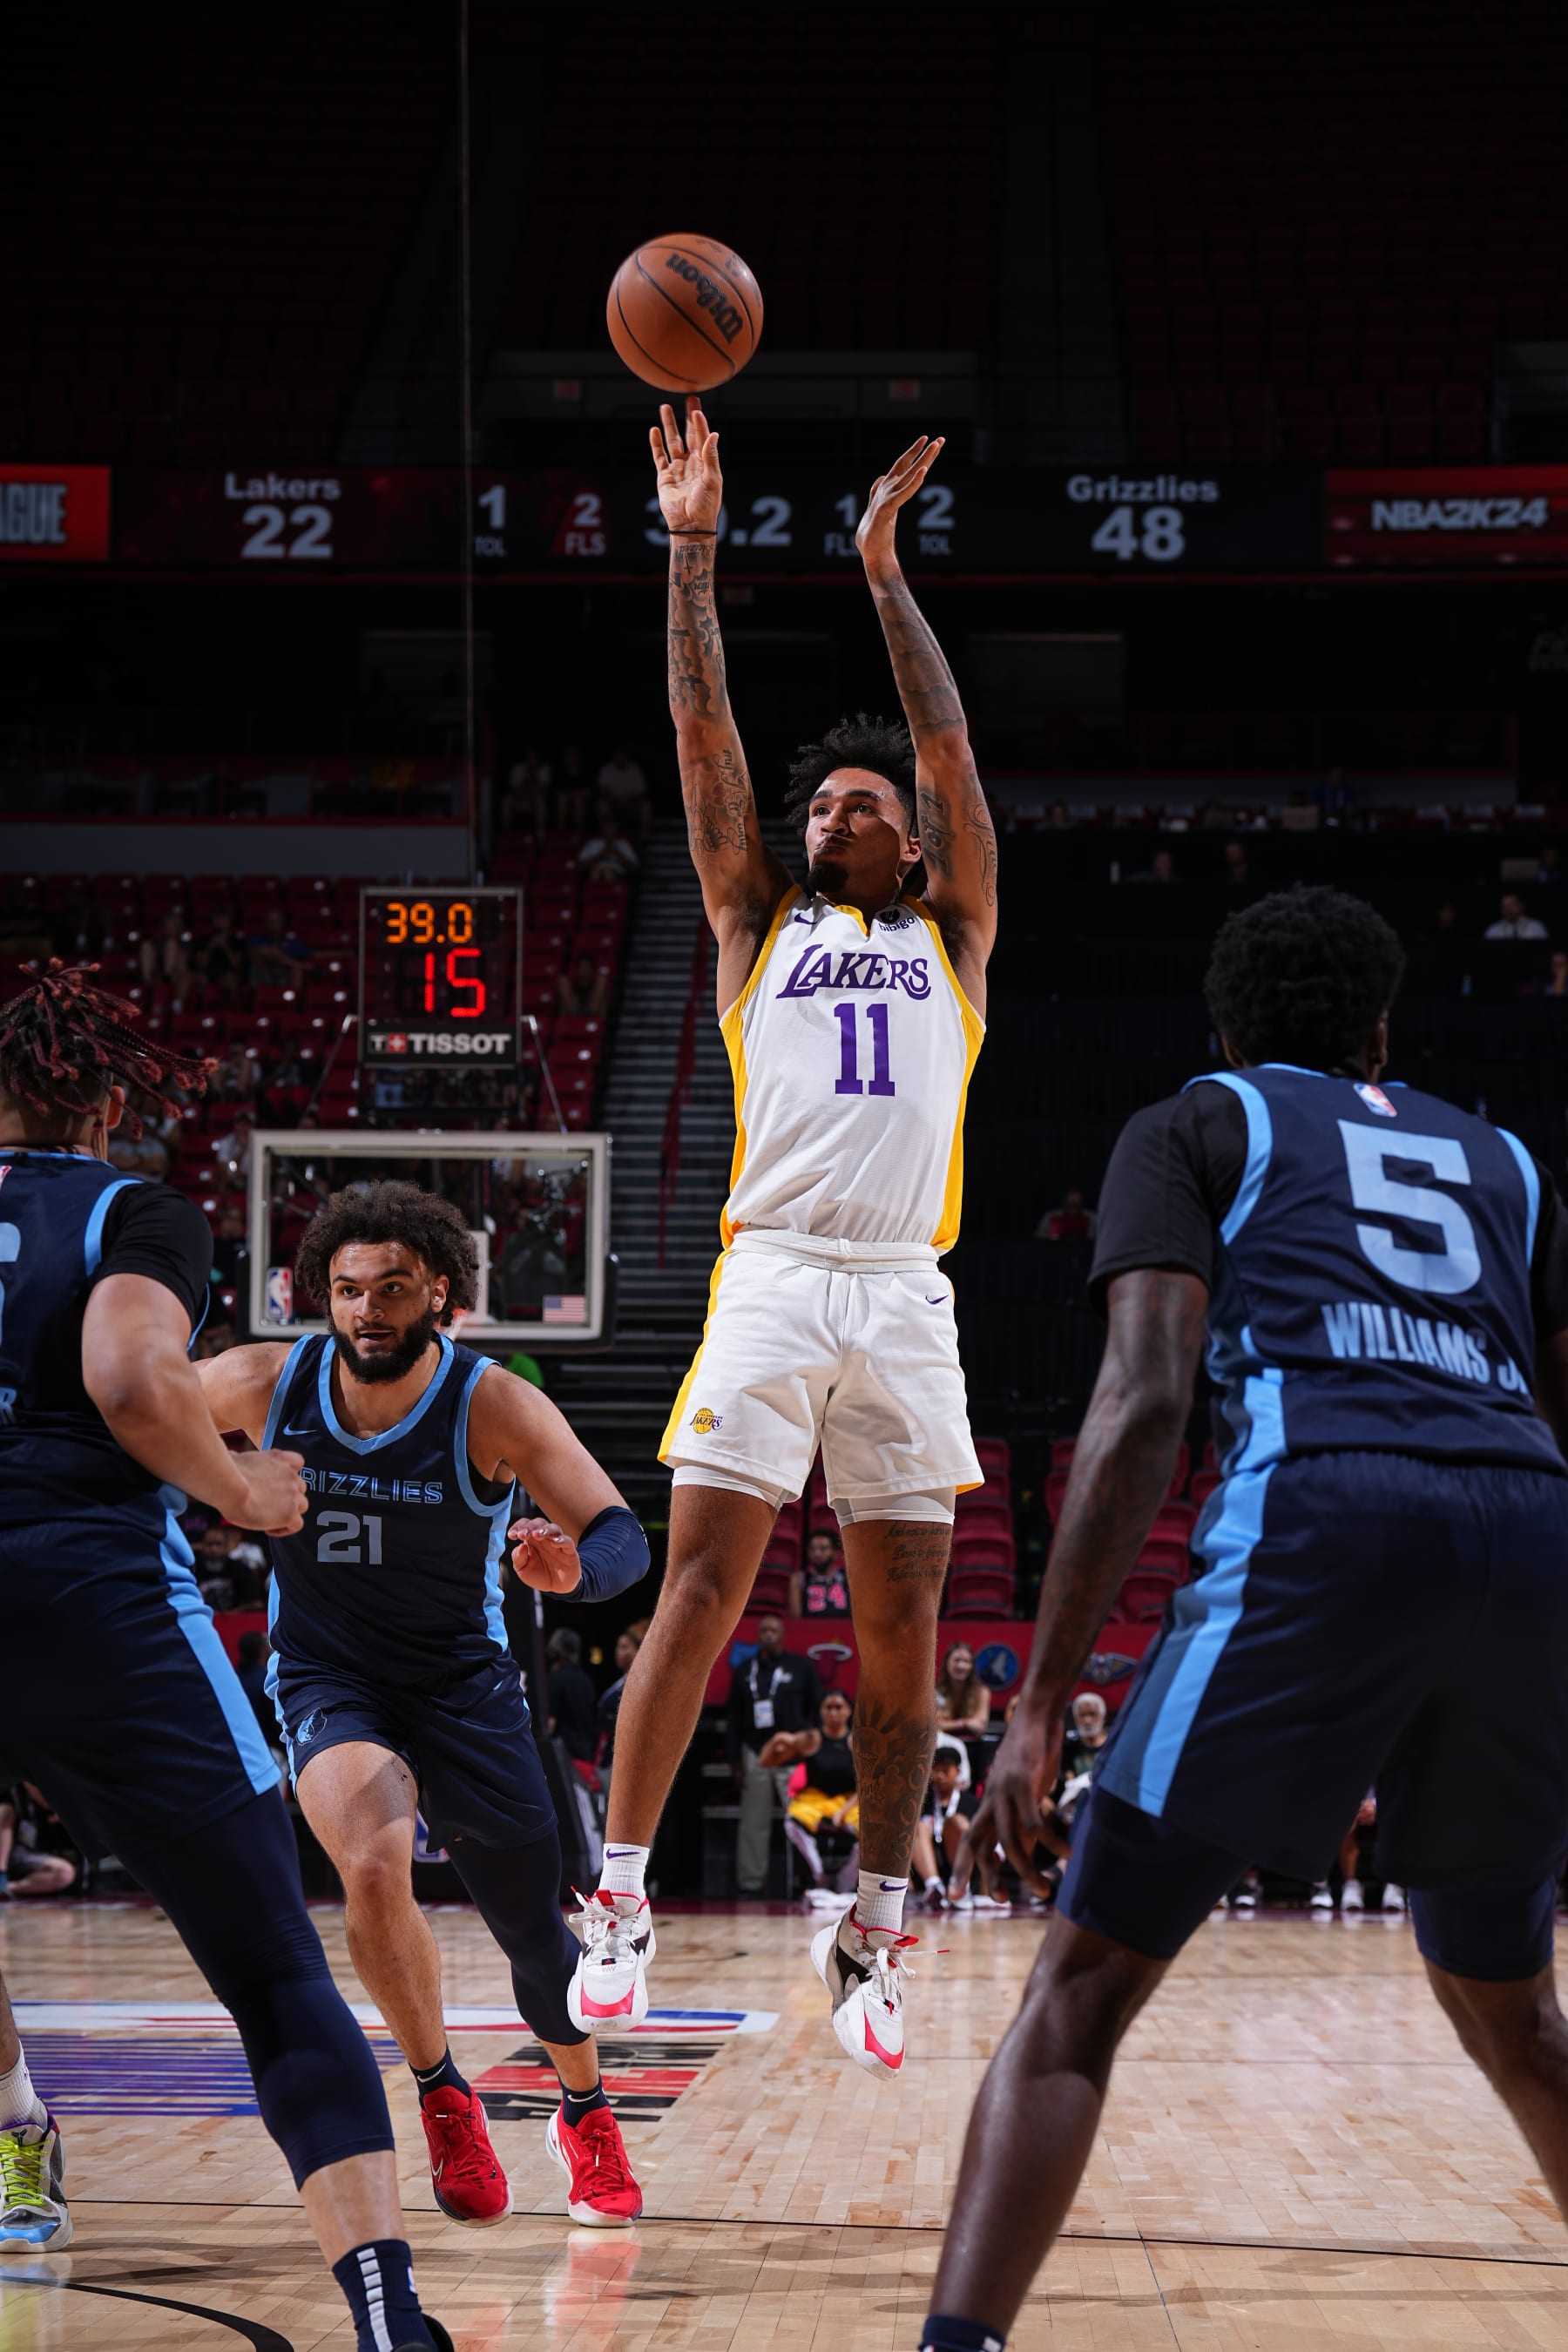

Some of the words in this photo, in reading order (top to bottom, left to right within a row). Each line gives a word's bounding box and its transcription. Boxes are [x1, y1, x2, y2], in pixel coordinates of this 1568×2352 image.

[666, 252, 743, 344] Wilson
[224, 471, 341, 502] Lakers
[478, 484, 507, 530] 1
[917, 484, 956, 529] 2
[1066, 475, 1220, 504] Grizzlies
[572, 493, 603, 529] 2
[835, 492, 857, 528] 1
[1370, 496, 1549, 532] NBA2K24
[240, 504, 335, 559] 22
[474, 537, 508, 558] TOL
[564, 532, 606, 557] FLS
[917, 534, 955, 556] TOL
[1091, 505, 1186, 562] 48
[386, 902, 473, 944] 39.0
[879, 916, 916, 932] bibigo
[424, 947, 487, 1018] 15
[775, 943, 931, 1001] LAKERS
[407, 1032, 512, 1055] TISSOT
[834, 1003, 896, 1097] 11
[1337, 1119, 1482, 1294] 5
[1321, 1301, 1490, 1385] WILLIAMS
[299, 1466, 443, 1504] RIZZLIES
[316, 1510, 382, 1565] 21
